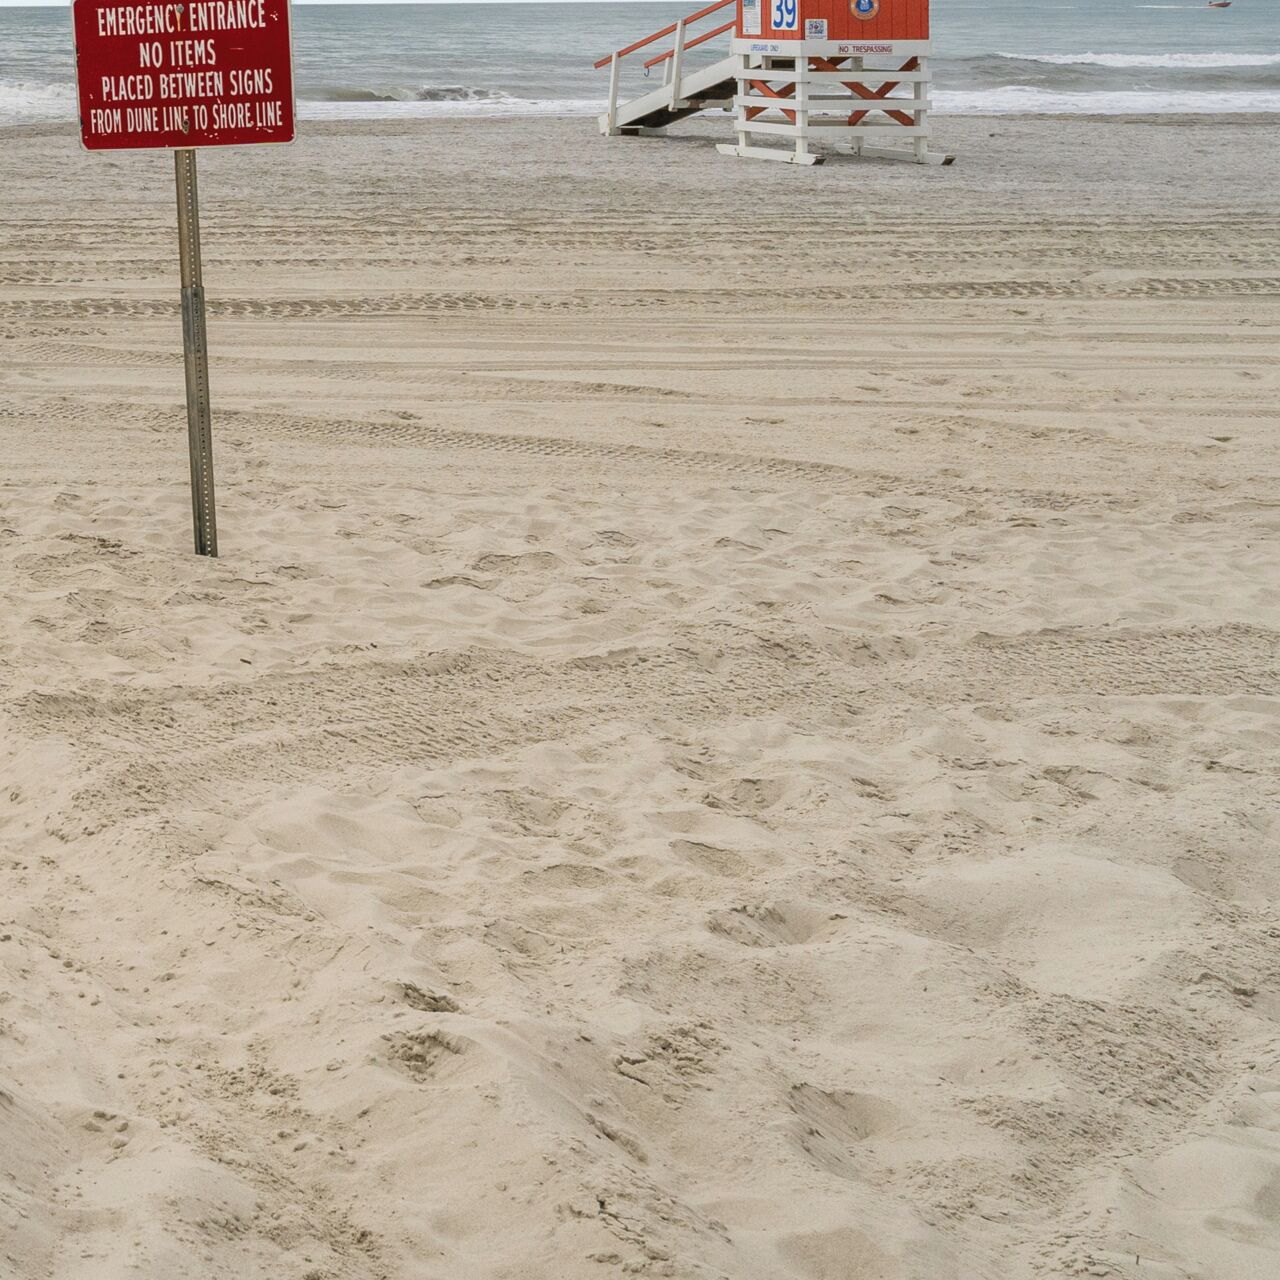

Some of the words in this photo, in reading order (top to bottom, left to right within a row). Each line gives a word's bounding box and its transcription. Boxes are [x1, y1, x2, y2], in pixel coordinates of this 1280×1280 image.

[98, 3, 183, 36] EMERGENCY
[189, 0, 266, 32] ENTRANCE
[139, 41, 162, 68] NO
[170, 39, 216, 66] ITEMS
[852, 45, 892, 53] TRESPASSING
[102, 75, 153, 101] PLACED
[160, 71, 224, 99] BETWEEN
[230, 68, 273, 96] SIGNS
[90, 108, 121, 134] FROM
[127, 107, 159, 132] DUNE
[193, 105, 208, 130] TO
[212, 102, 251, 130] SHORE
[256, 101, 283, 127] LINE
